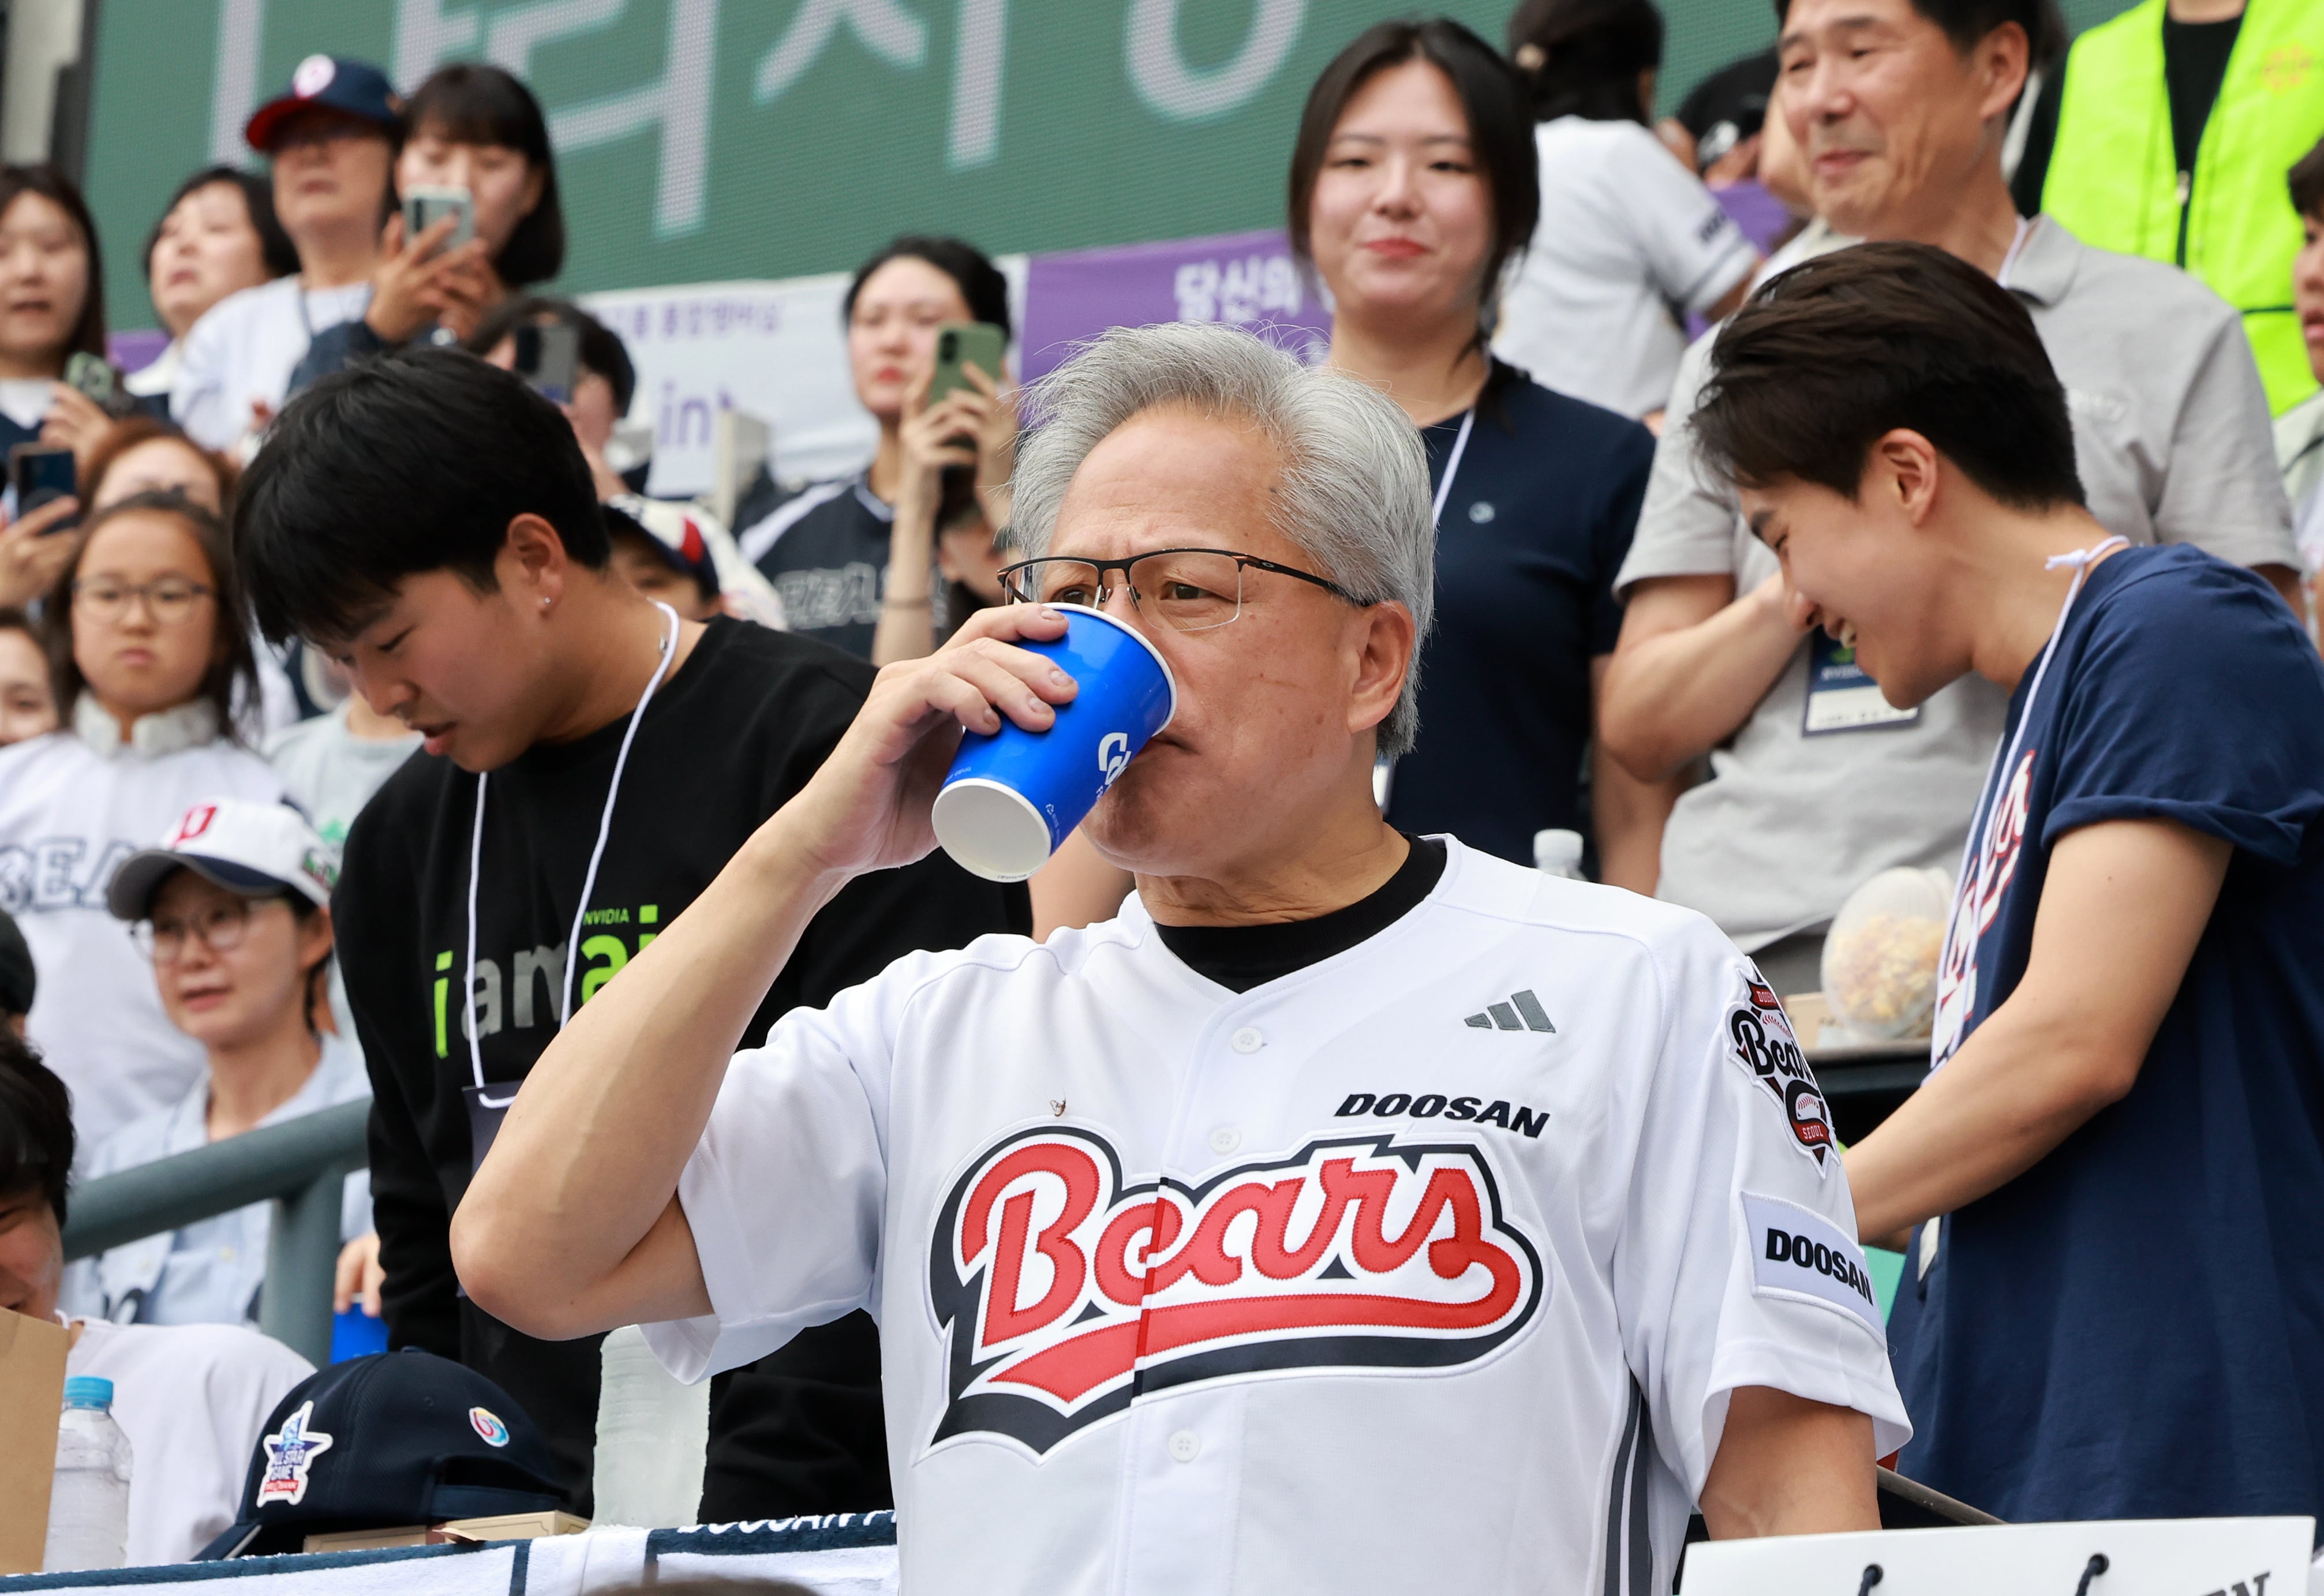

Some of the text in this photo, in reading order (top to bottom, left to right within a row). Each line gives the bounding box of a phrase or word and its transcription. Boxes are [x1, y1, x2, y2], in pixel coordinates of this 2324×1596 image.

[582, 907, 631, 926] NVIDIA
[1333, 1093, 1551, 1139] DOOSAN
[1802, 1125, 1824, 1140] SEOUL
[959, 1141, 1522, 1404] Bears
[1765, 1227, 1874, 1307] DOOSAN
